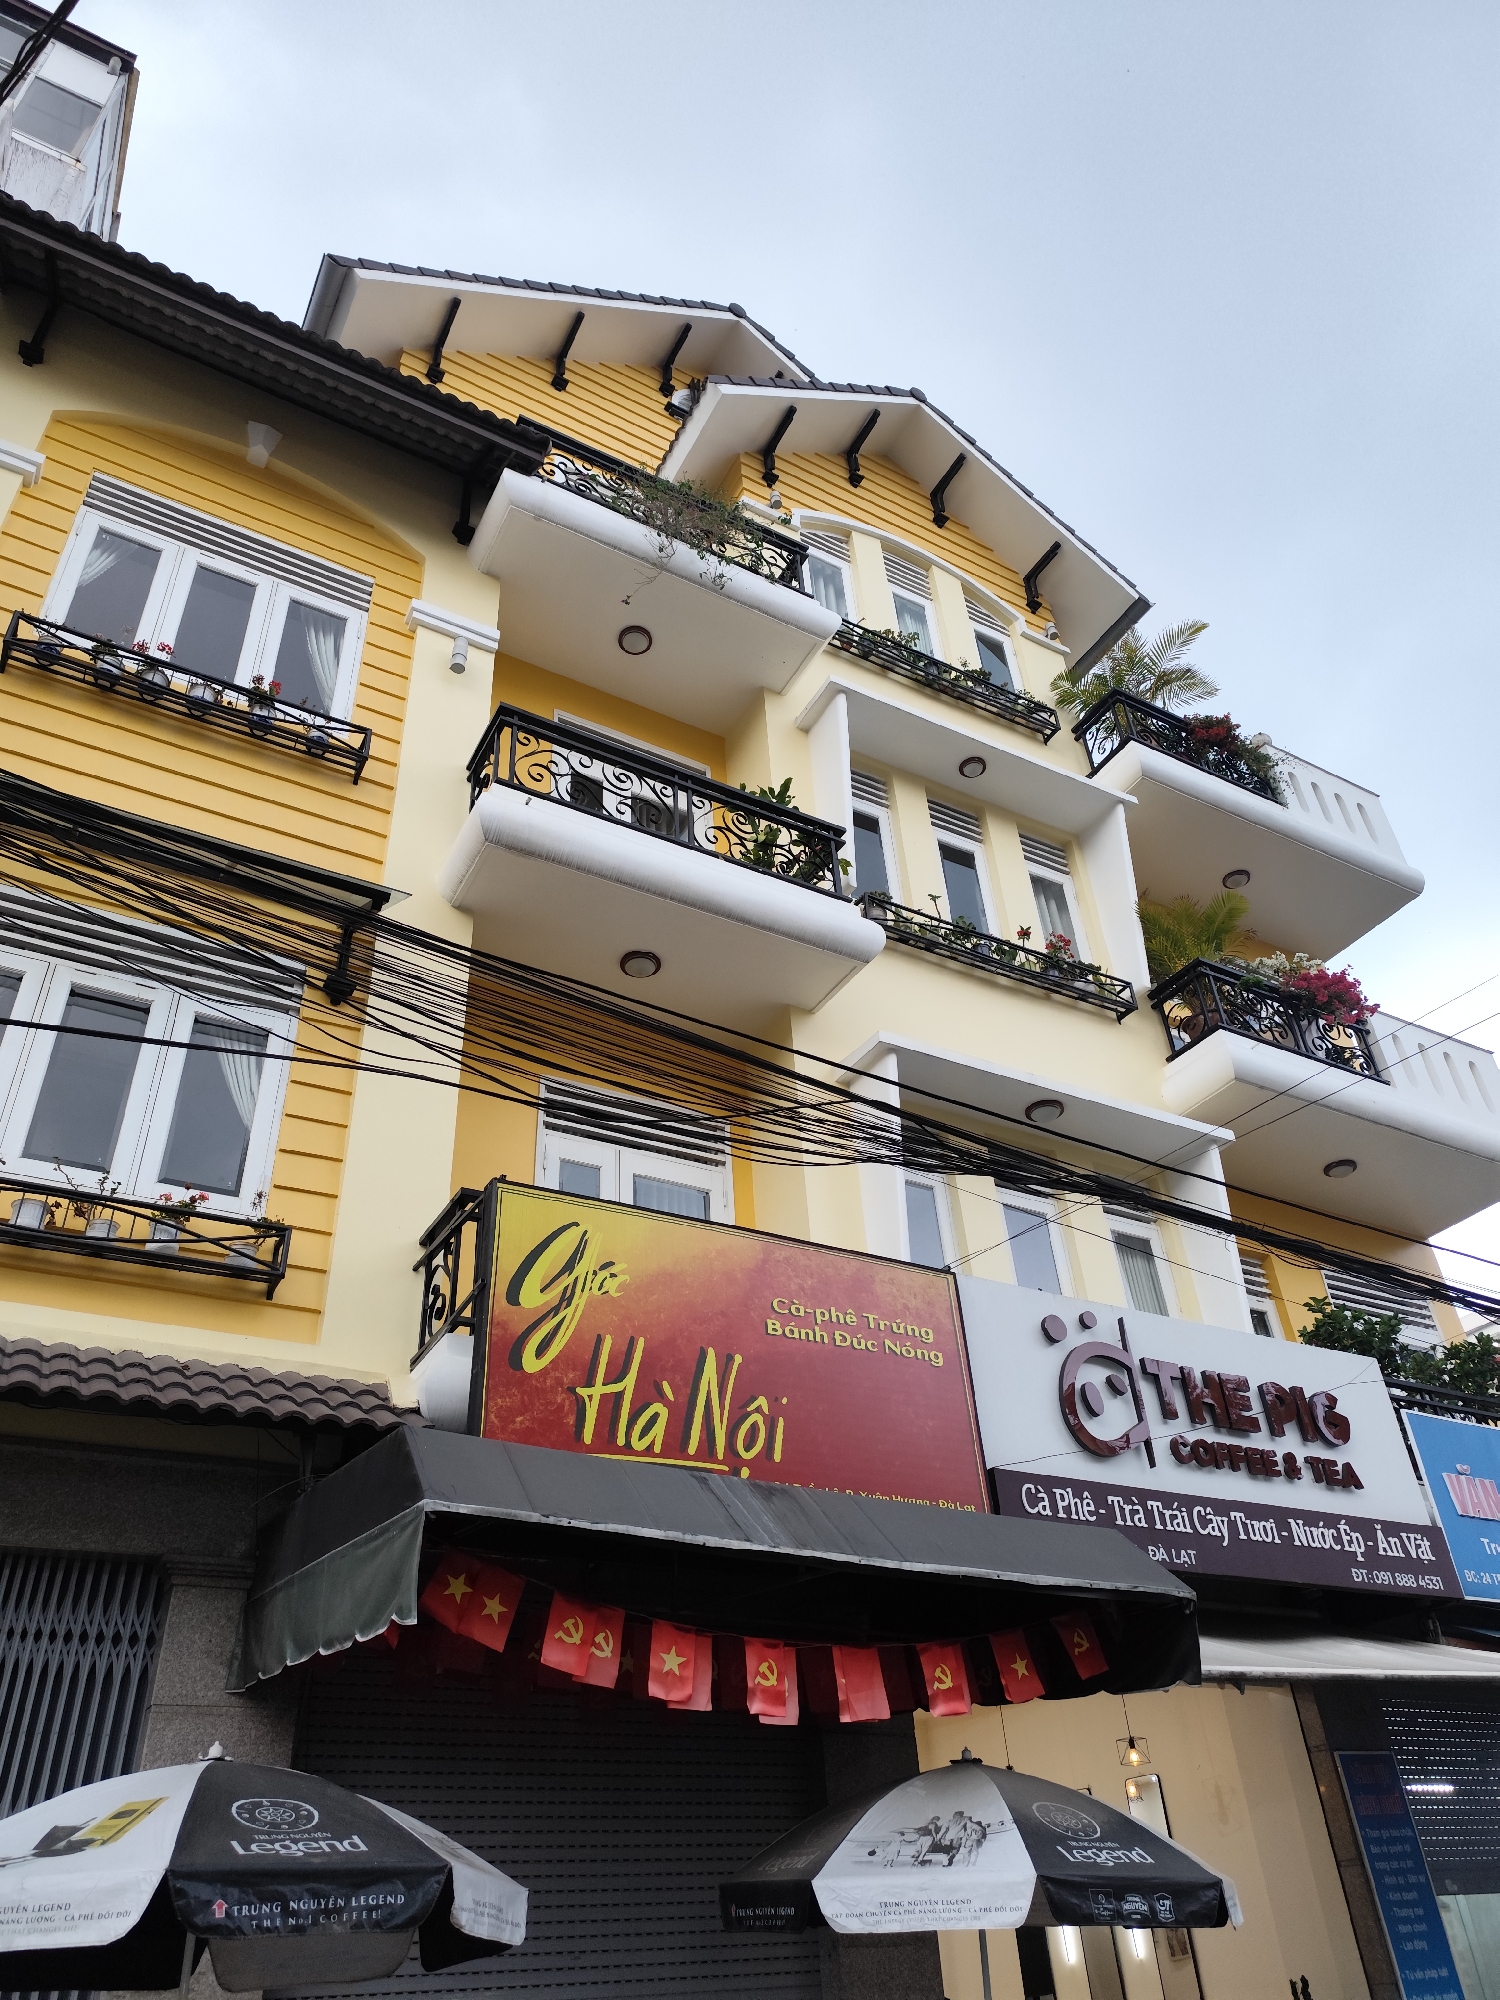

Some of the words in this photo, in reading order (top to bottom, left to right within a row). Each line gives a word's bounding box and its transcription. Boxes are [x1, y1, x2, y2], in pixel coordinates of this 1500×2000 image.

[771, 1298, 858, 1326] Cà-phê
[862, 1312, 934, 1343] Trứng
[766, 1318, 828, 1344] Bánh
[834, 1329, 878, 1352] Đúc
[883, 1338, 944, 1367] Nóng
[573, 1334, 674, 1452] Hà
[686, 1346, 788, 1480] Nội
[1139, 1356, 1262, 1433] THE
[1257, 1381, 1351, 1447] PIG
[1170, 1435, 1282, 1477] COFFEE
[1282, 1451, 1304, 1481] &
[1304, 1456, 1365, 1490] TEA
[1021, 1483, 1052, 1516] Cà
[1052, 1487, 1097, 1521] Phê
[1107, 1495, 1148, 1528] Trà
[1147, 1500, 1193, 1533] Trái
[1192, 1505, 1229, 1547] Cây
[1230, 1511, 1281, 1544] Tươi
[1287, 1518, 1341, 1550] Nước
[1337, 1519, 1365, 1561] Ép
[1374, 1523, 1405, 1558] Ăn
[1400, 1532, 1436, 1564] Vặt
[1147, 1543, 1170, 1562] ĐÀ
[1171, 1549, 1197, 1567] LẠT
[1395, 1573, 1417, 1587] 888
[1418, 1575, 1444, 1590] 4531
[230, 1835, 369, 1857] Legend
[1056, 1846, 1155, 1866] Legend
[32, 1902, 71, 1913] LEGEND
[232, 1902, 282, 1917] TRUNG
[289, 1894, 345, 1910] NGUYÊN
[351, 1894, 405, 1907] LEGEND
[879, 1901, 905, 1909] TRUNG
[907, 1898, 939, 1907] NGUYÊN
[941, 1898, 972, 1906] LEGEND
[251, 1917, 282, 1928] THE
